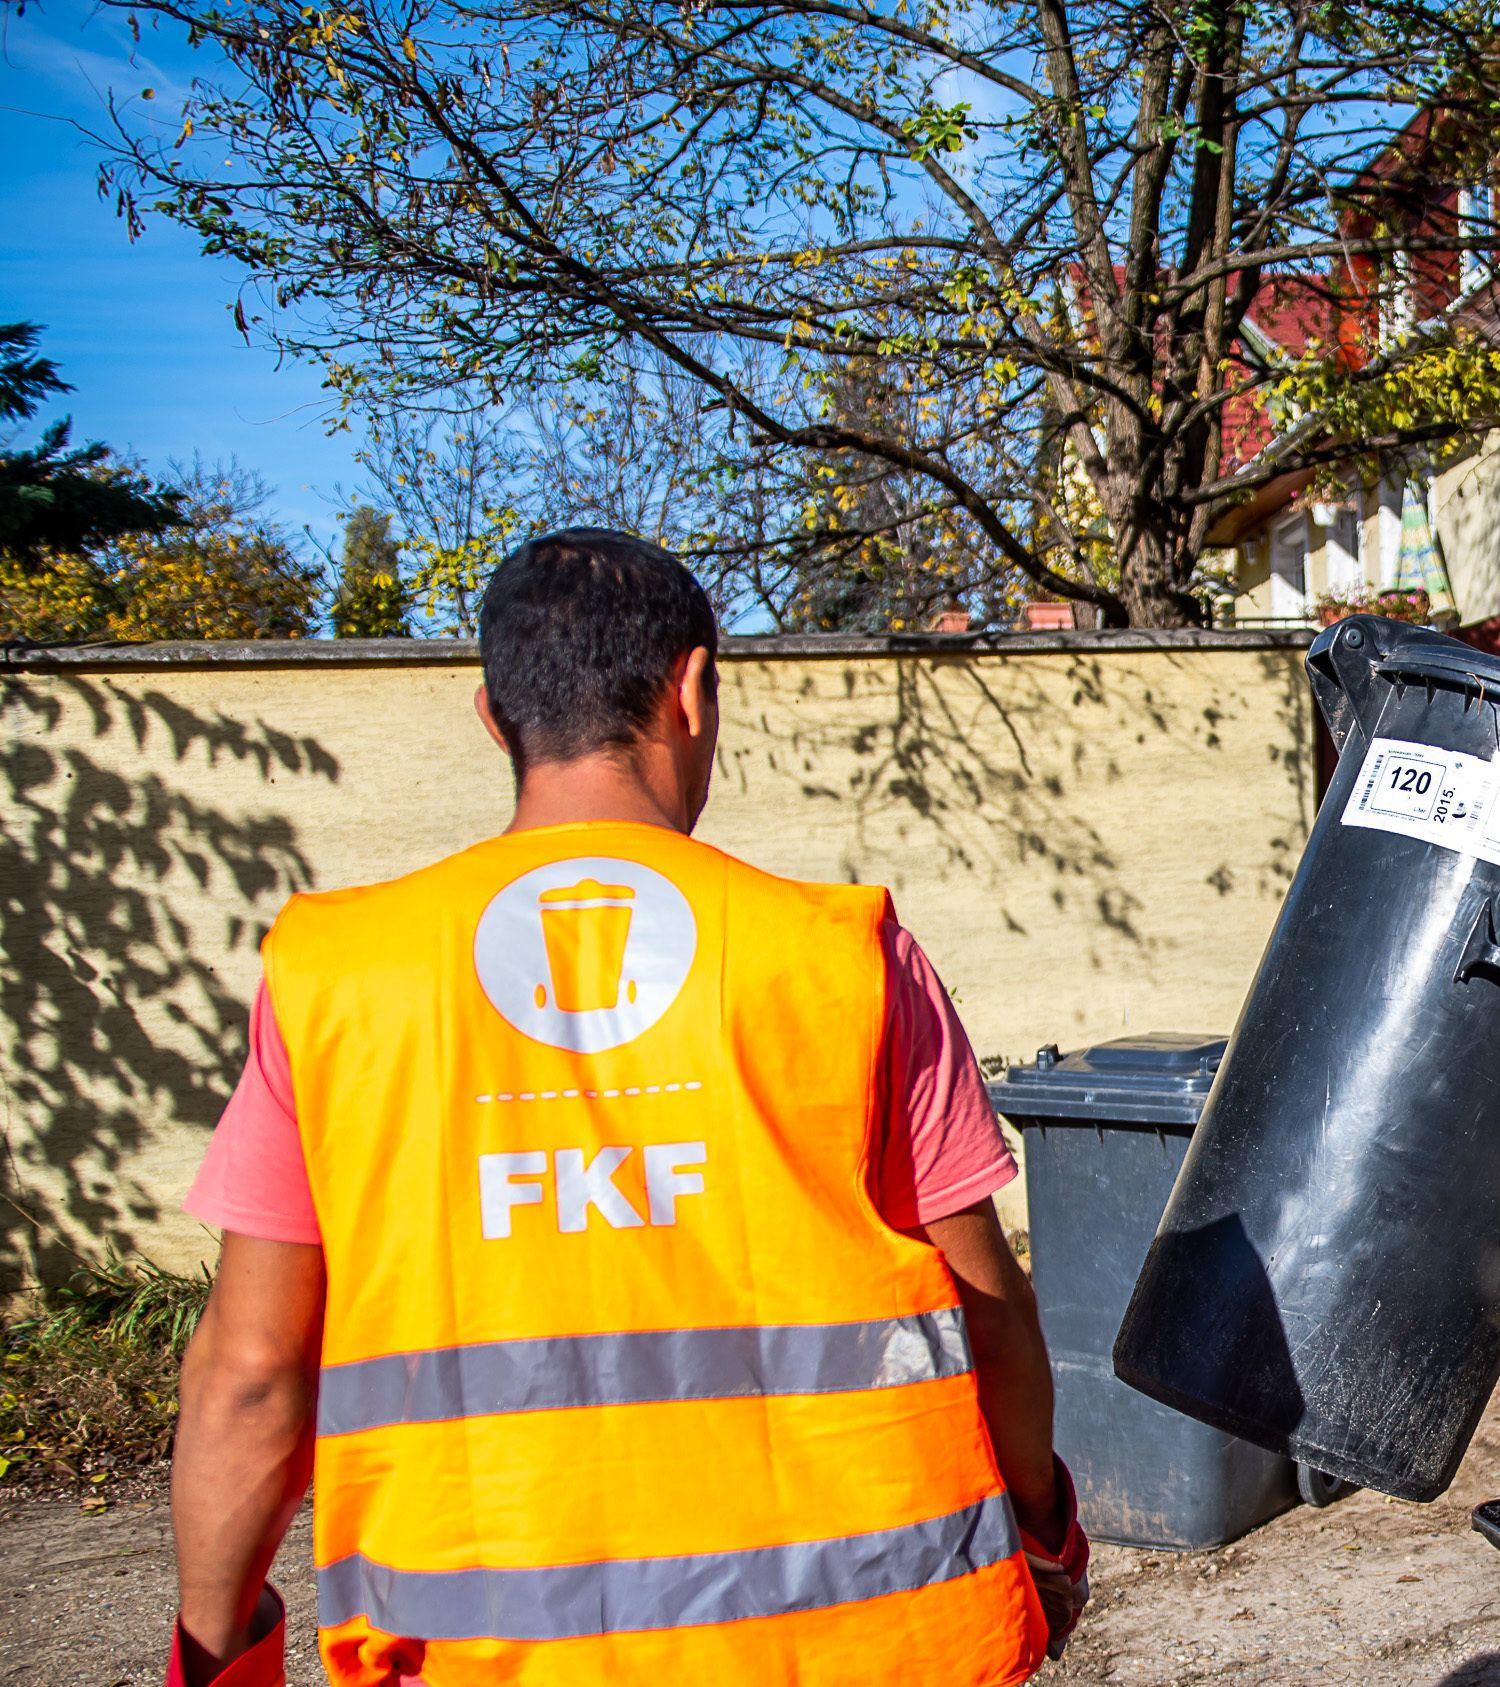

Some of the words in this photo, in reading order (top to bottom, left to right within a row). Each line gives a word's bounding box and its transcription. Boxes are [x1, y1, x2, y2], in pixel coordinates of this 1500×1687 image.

[1391, 766, 1432, 795] 120
[1433, 787, 1456, 824] 2015.
[478, 1141, 707, 1240] FKF
